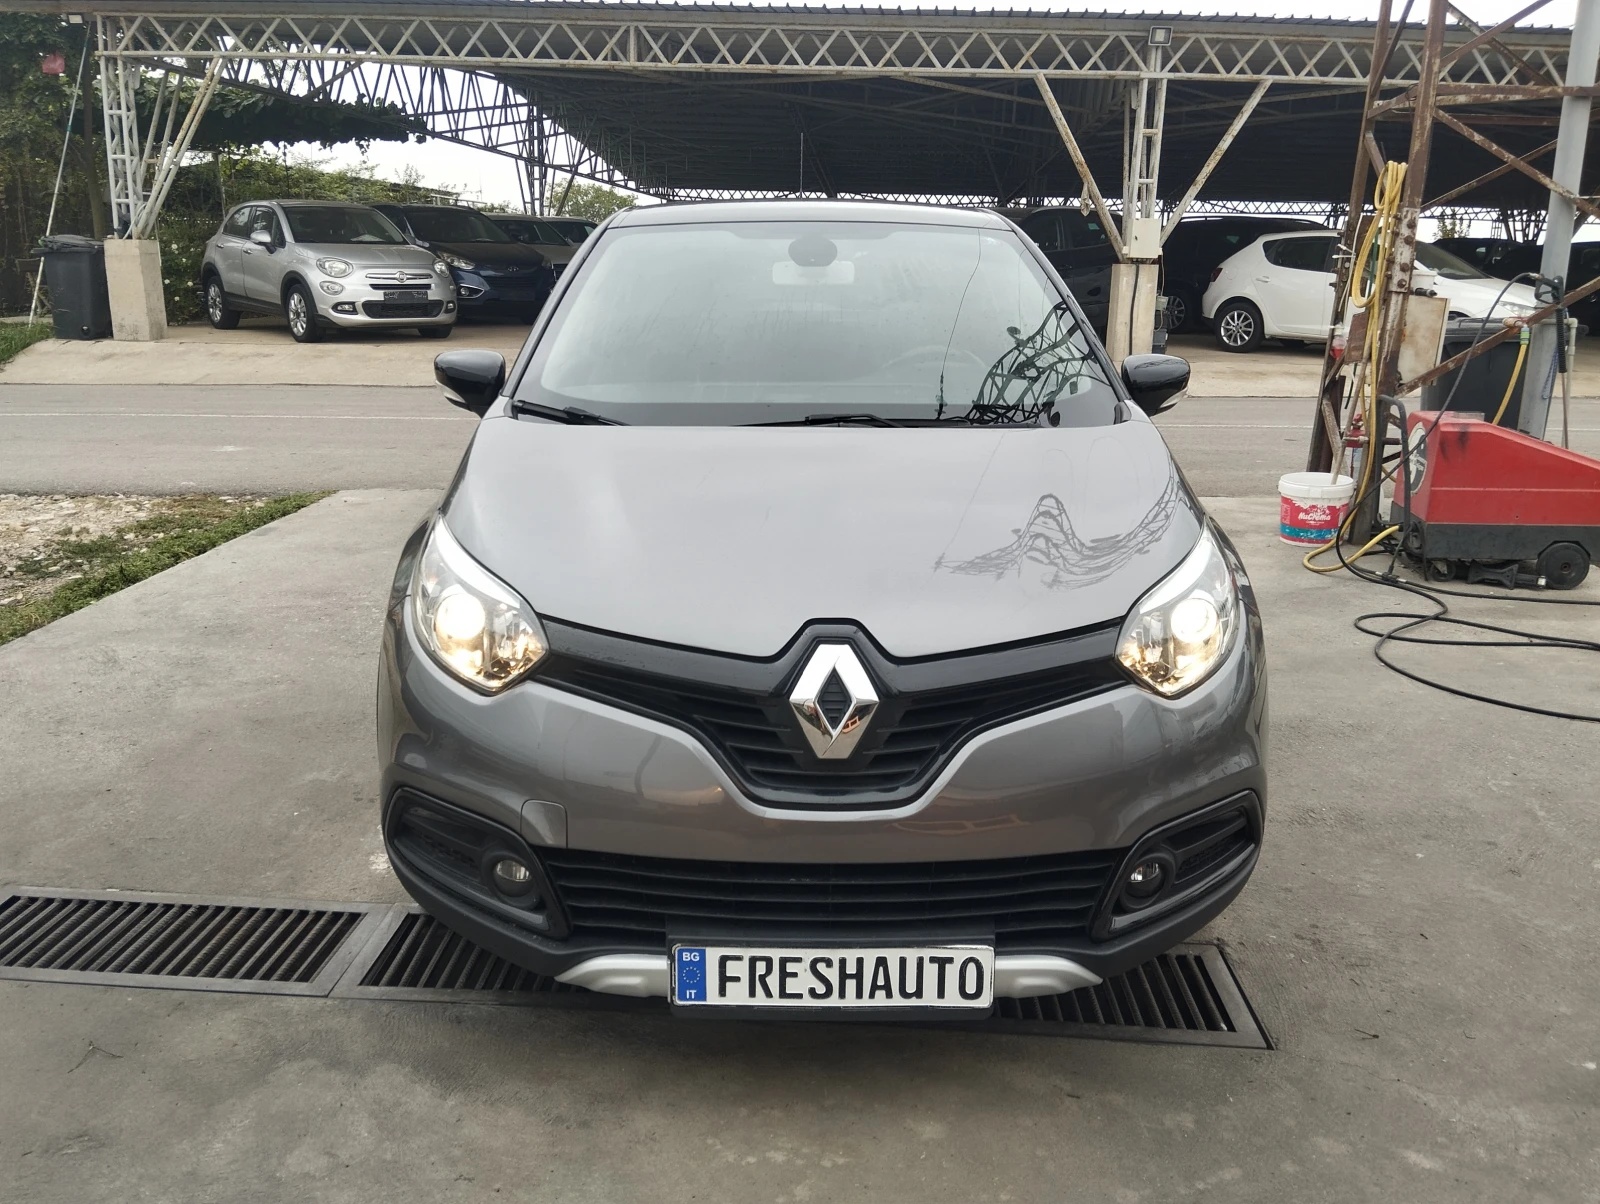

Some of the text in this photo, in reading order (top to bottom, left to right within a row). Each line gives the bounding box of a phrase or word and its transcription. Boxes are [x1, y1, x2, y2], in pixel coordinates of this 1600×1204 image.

[682, 952, 700, 962] BG
[717, 954, 984, 1000] FRESHAUTO
[686, 989, 697, 999] IT
